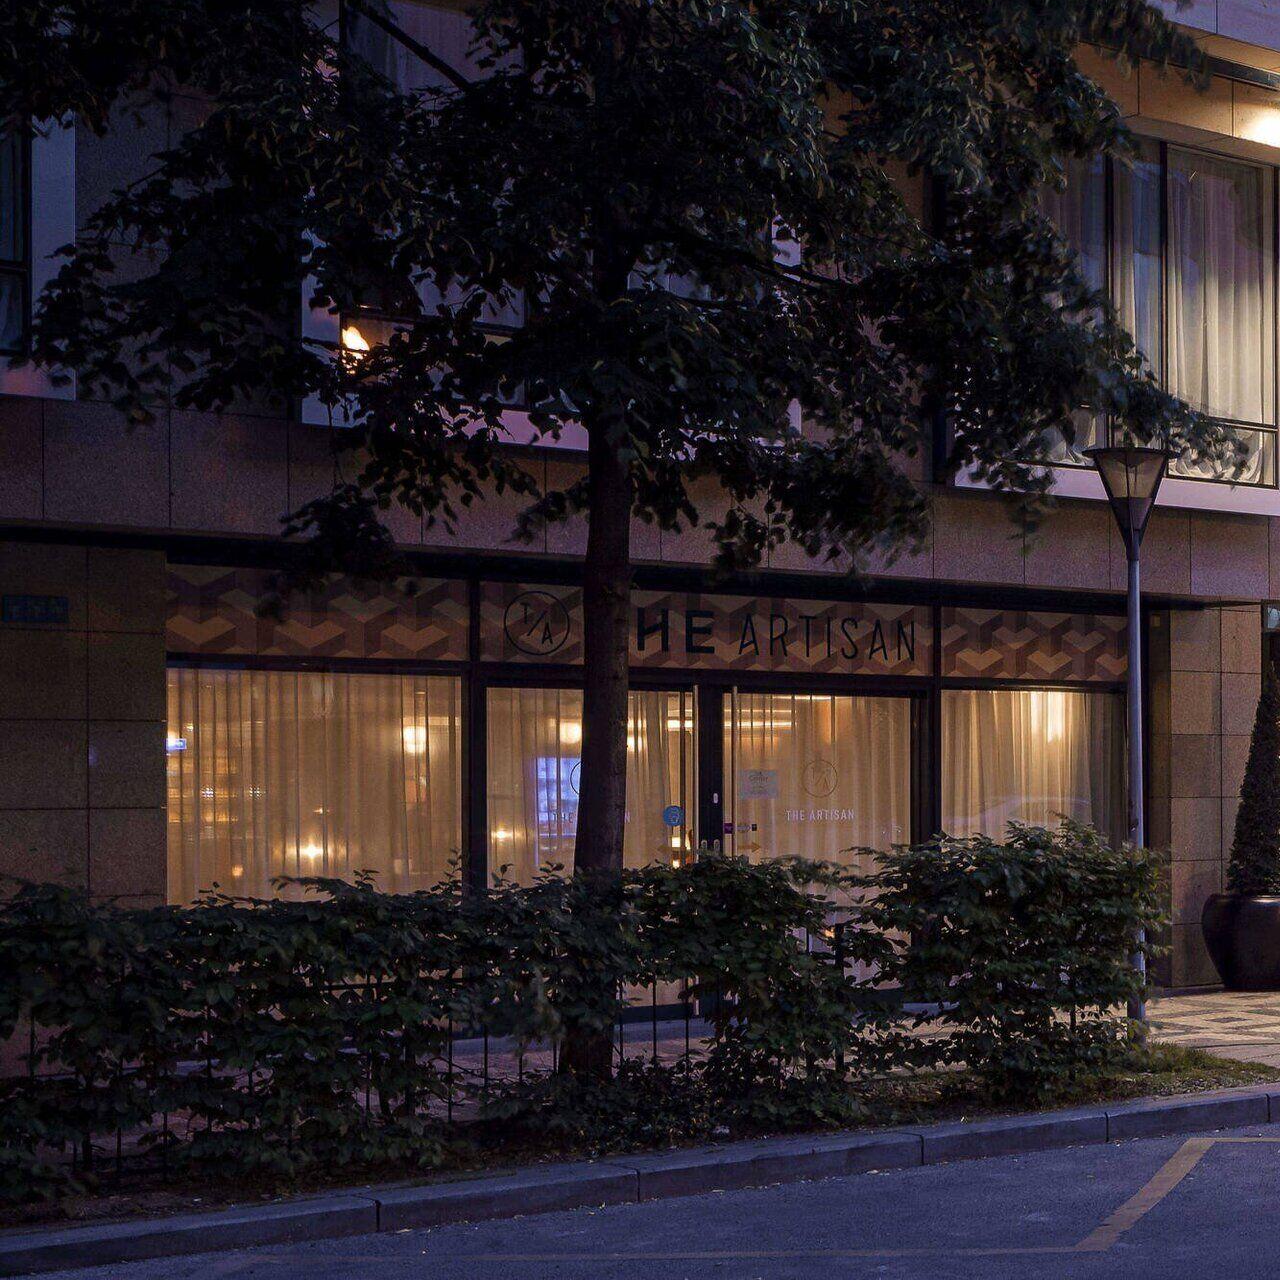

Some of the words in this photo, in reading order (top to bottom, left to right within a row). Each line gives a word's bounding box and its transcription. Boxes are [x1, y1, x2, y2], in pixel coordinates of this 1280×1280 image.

[636, 606, 716, 654] HE
[739, 613, 918, 662] ARTISAN
[785, 809, 806, 821] THE
[808, 808, 856, 821] ARTISAN
